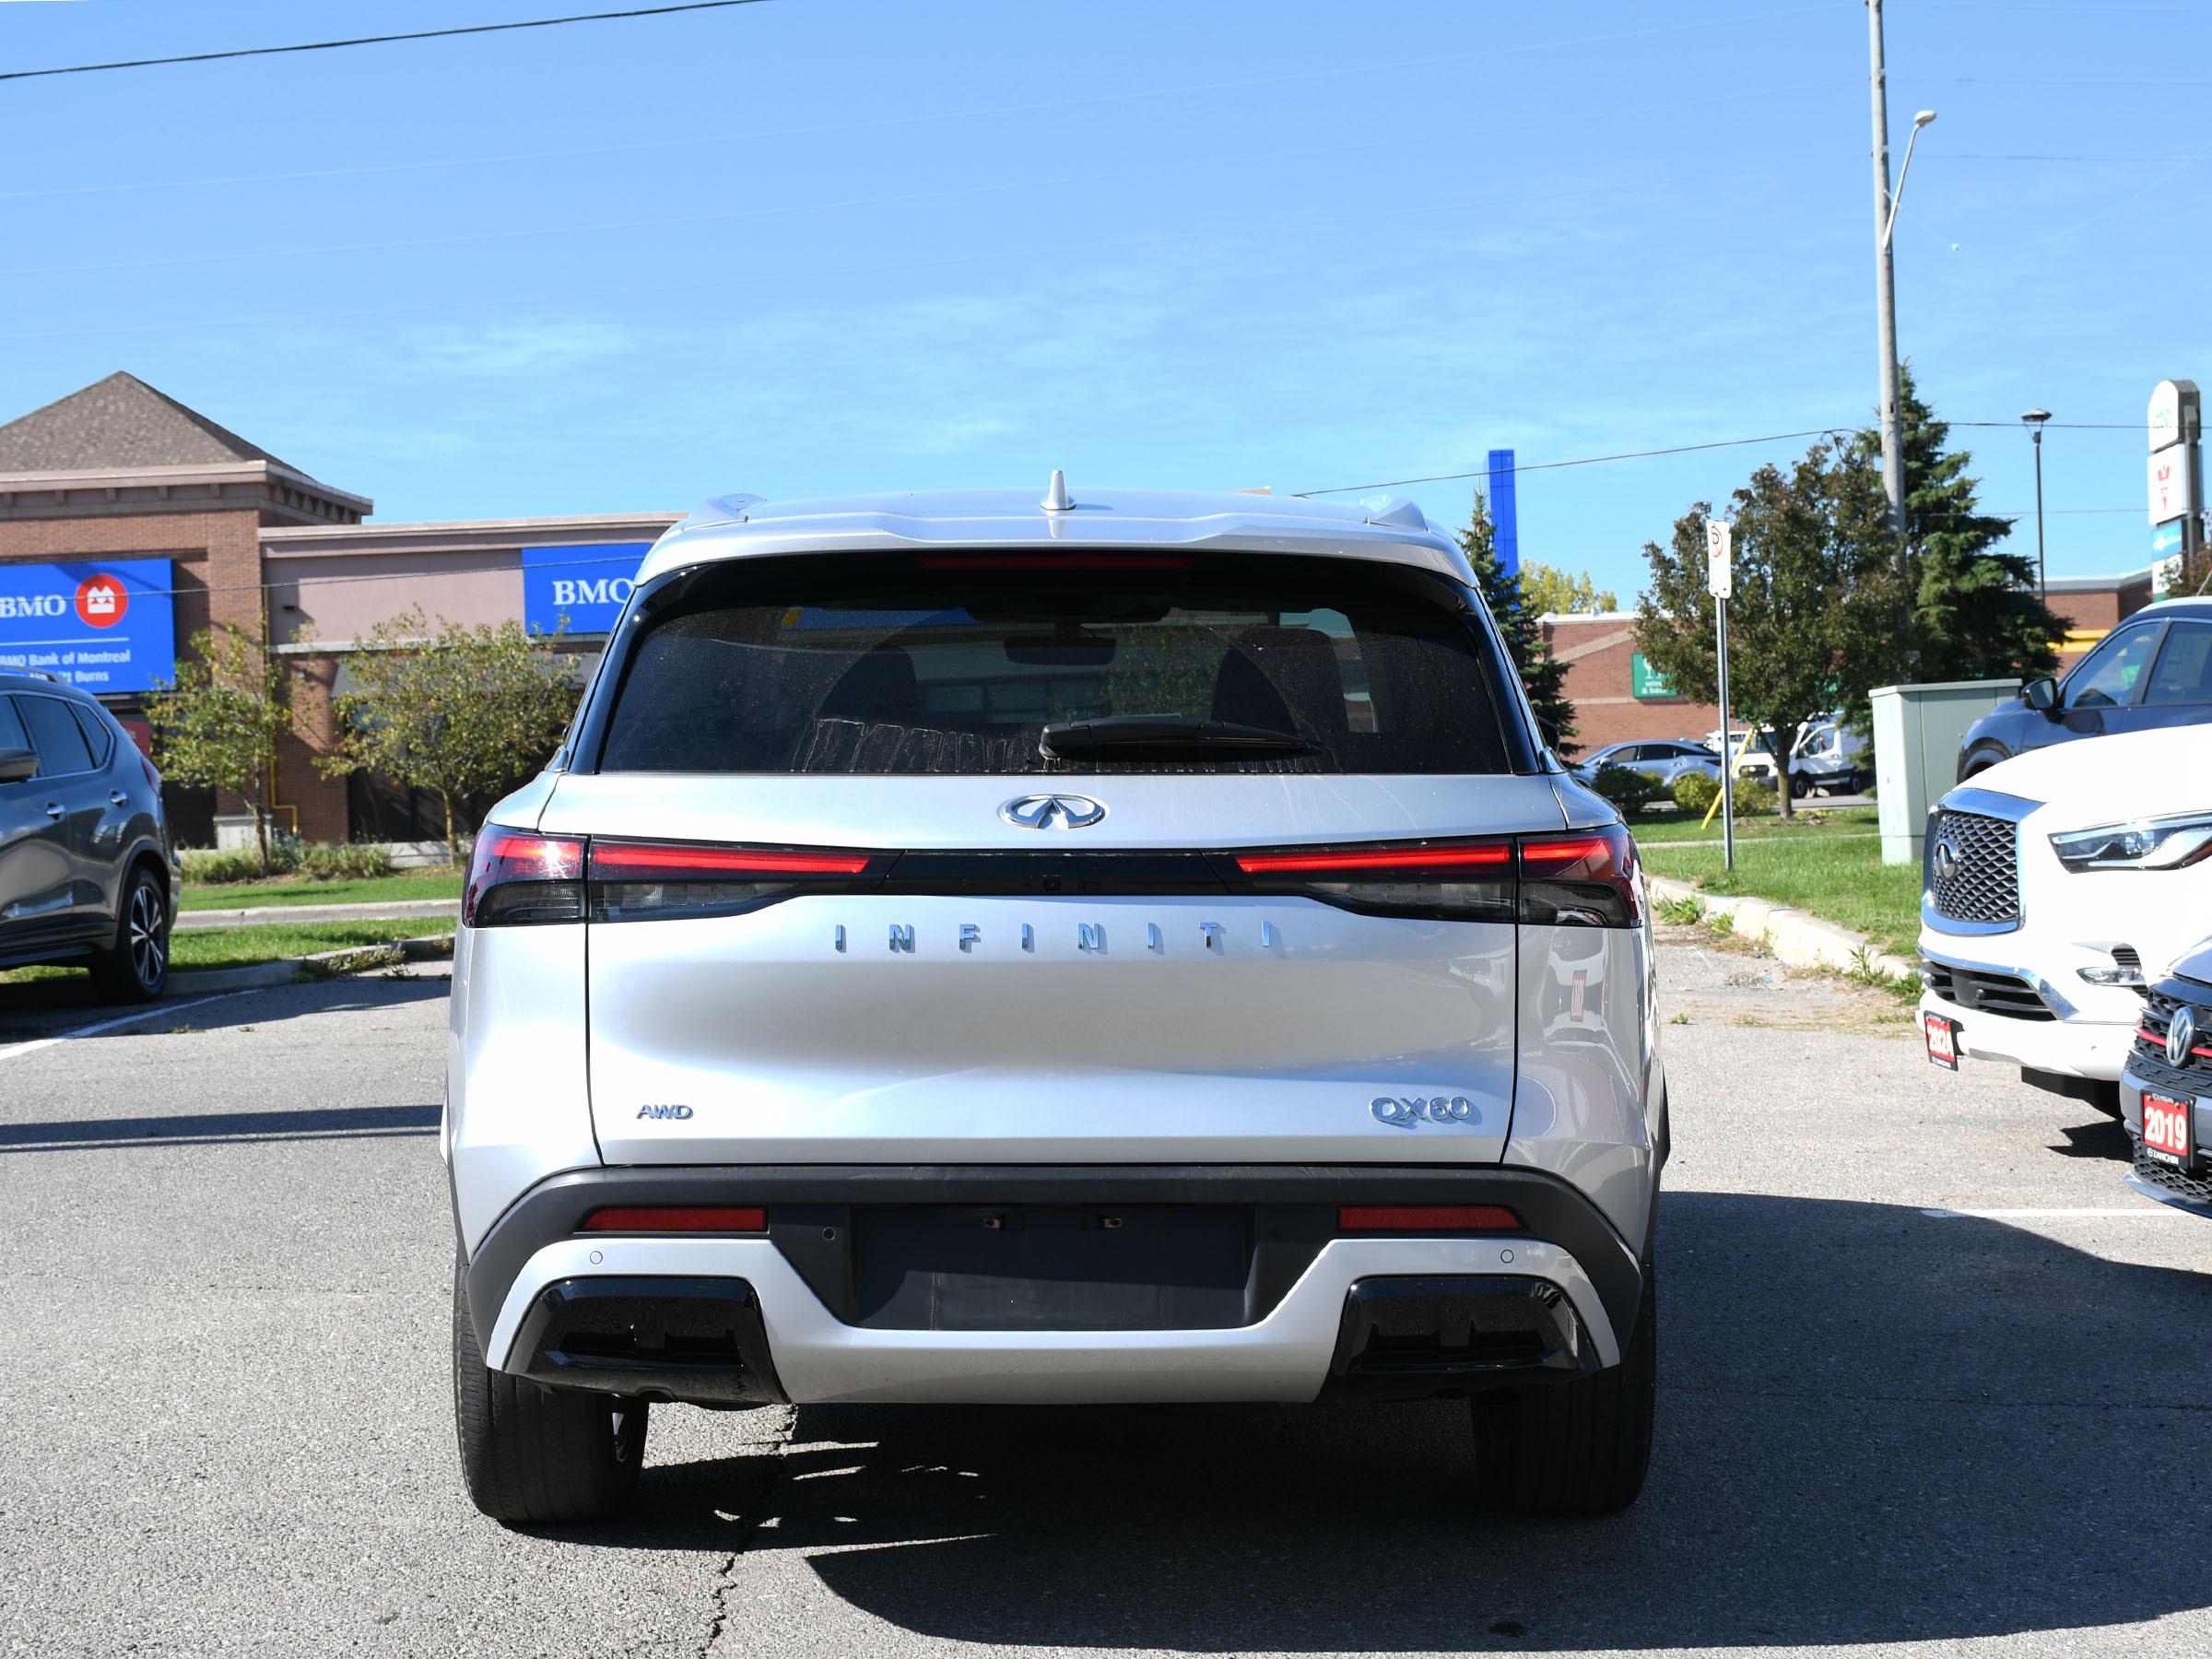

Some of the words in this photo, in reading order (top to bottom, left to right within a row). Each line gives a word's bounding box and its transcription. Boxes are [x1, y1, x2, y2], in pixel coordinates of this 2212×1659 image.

[553, 578, 633, 606] BMO
[0, 594, 66, 618] BMO
[29, 653, 59, 665] Bank
[62, 651, 75, 665] of
[77, 649, 130, 664] Montreal
[75, 670, 109, 683] Burns
[835, 922, 1270, 951] INFINITI
[636, 1104, 694, 1120] AWD
[1369, 1096, 1472, 1126] QX60
[2145, 1106, 2186, 1150] 2019
